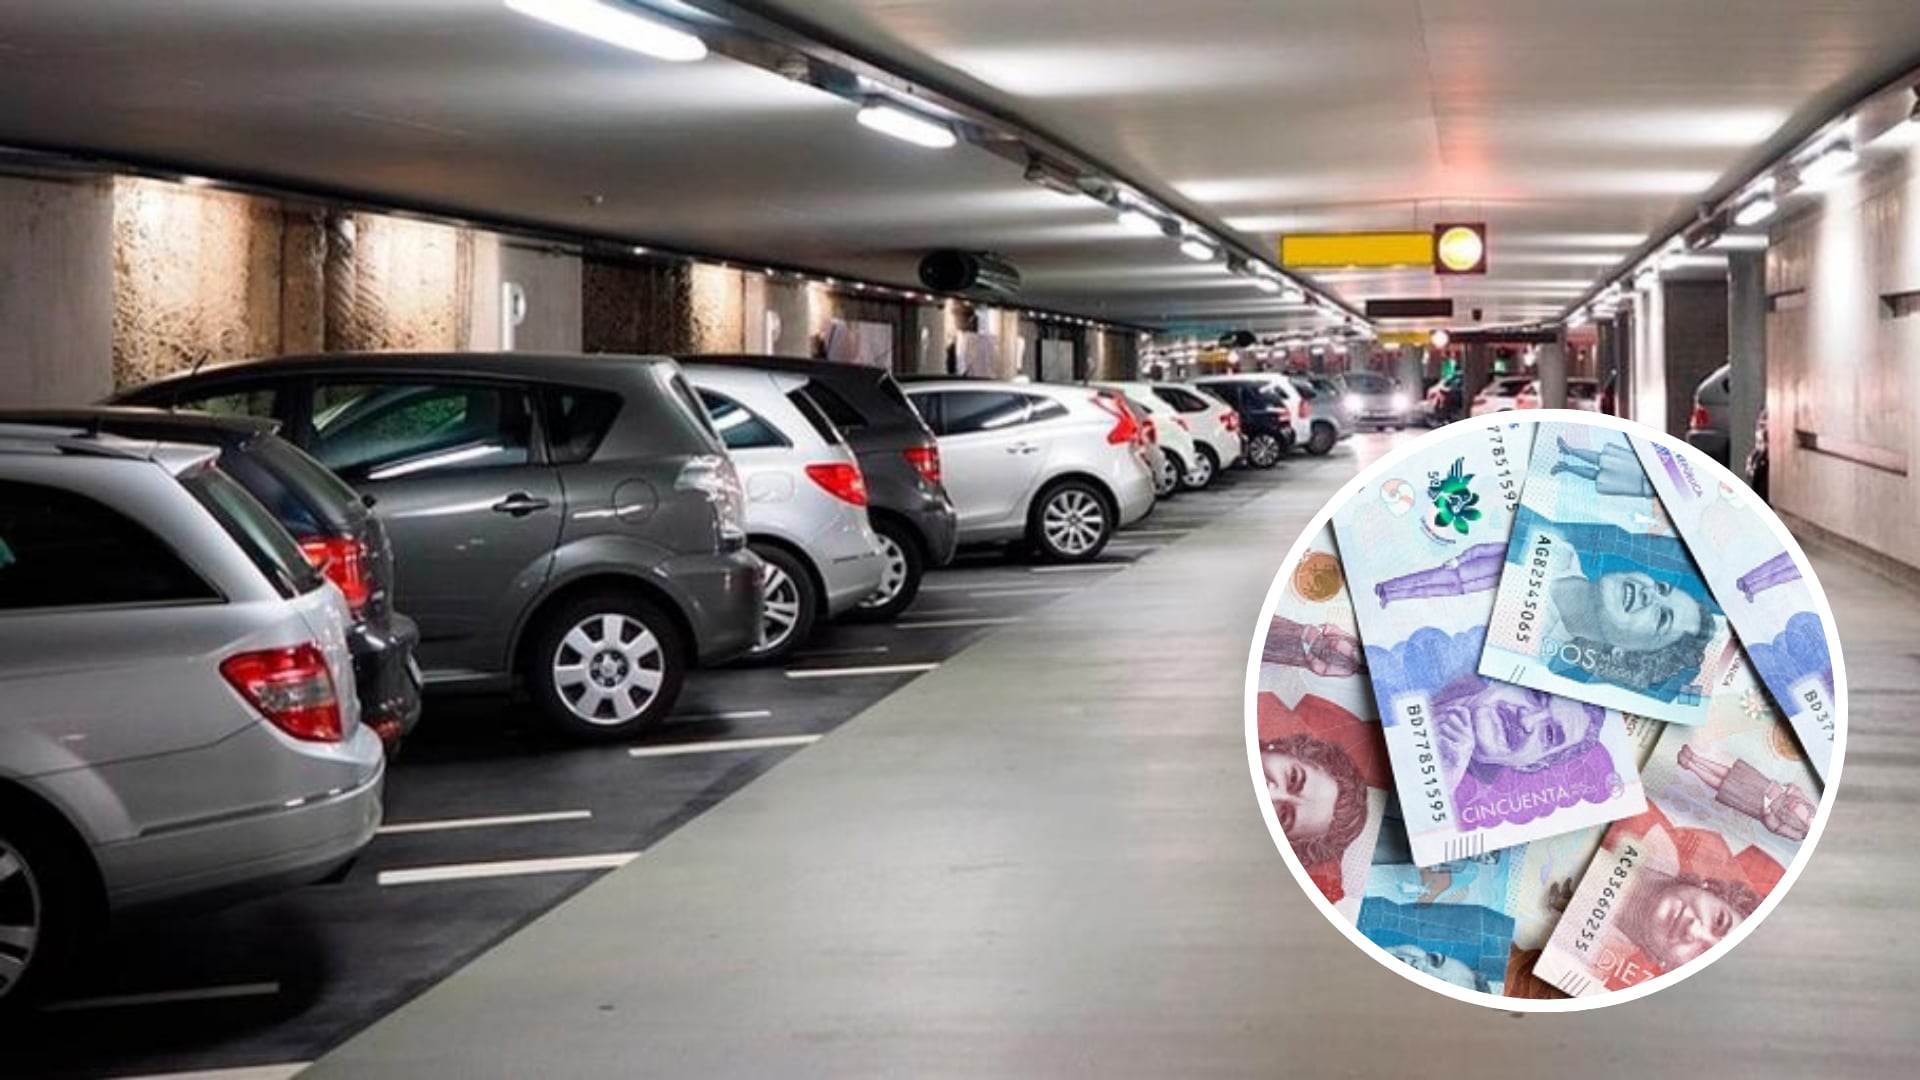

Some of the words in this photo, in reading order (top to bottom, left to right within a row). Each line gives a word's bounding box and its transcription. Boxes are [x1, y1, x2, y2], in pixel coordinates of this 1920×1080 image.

[1516, 534, 1552, 643] AG82545065
[1541, 636, 1597, 670] DOS
[1406, 704, 1448, 823] BD77851595
[1461, 785, 1571, 824] CINCUENTA
[1575, 845, 1639, 952] AC83660255
